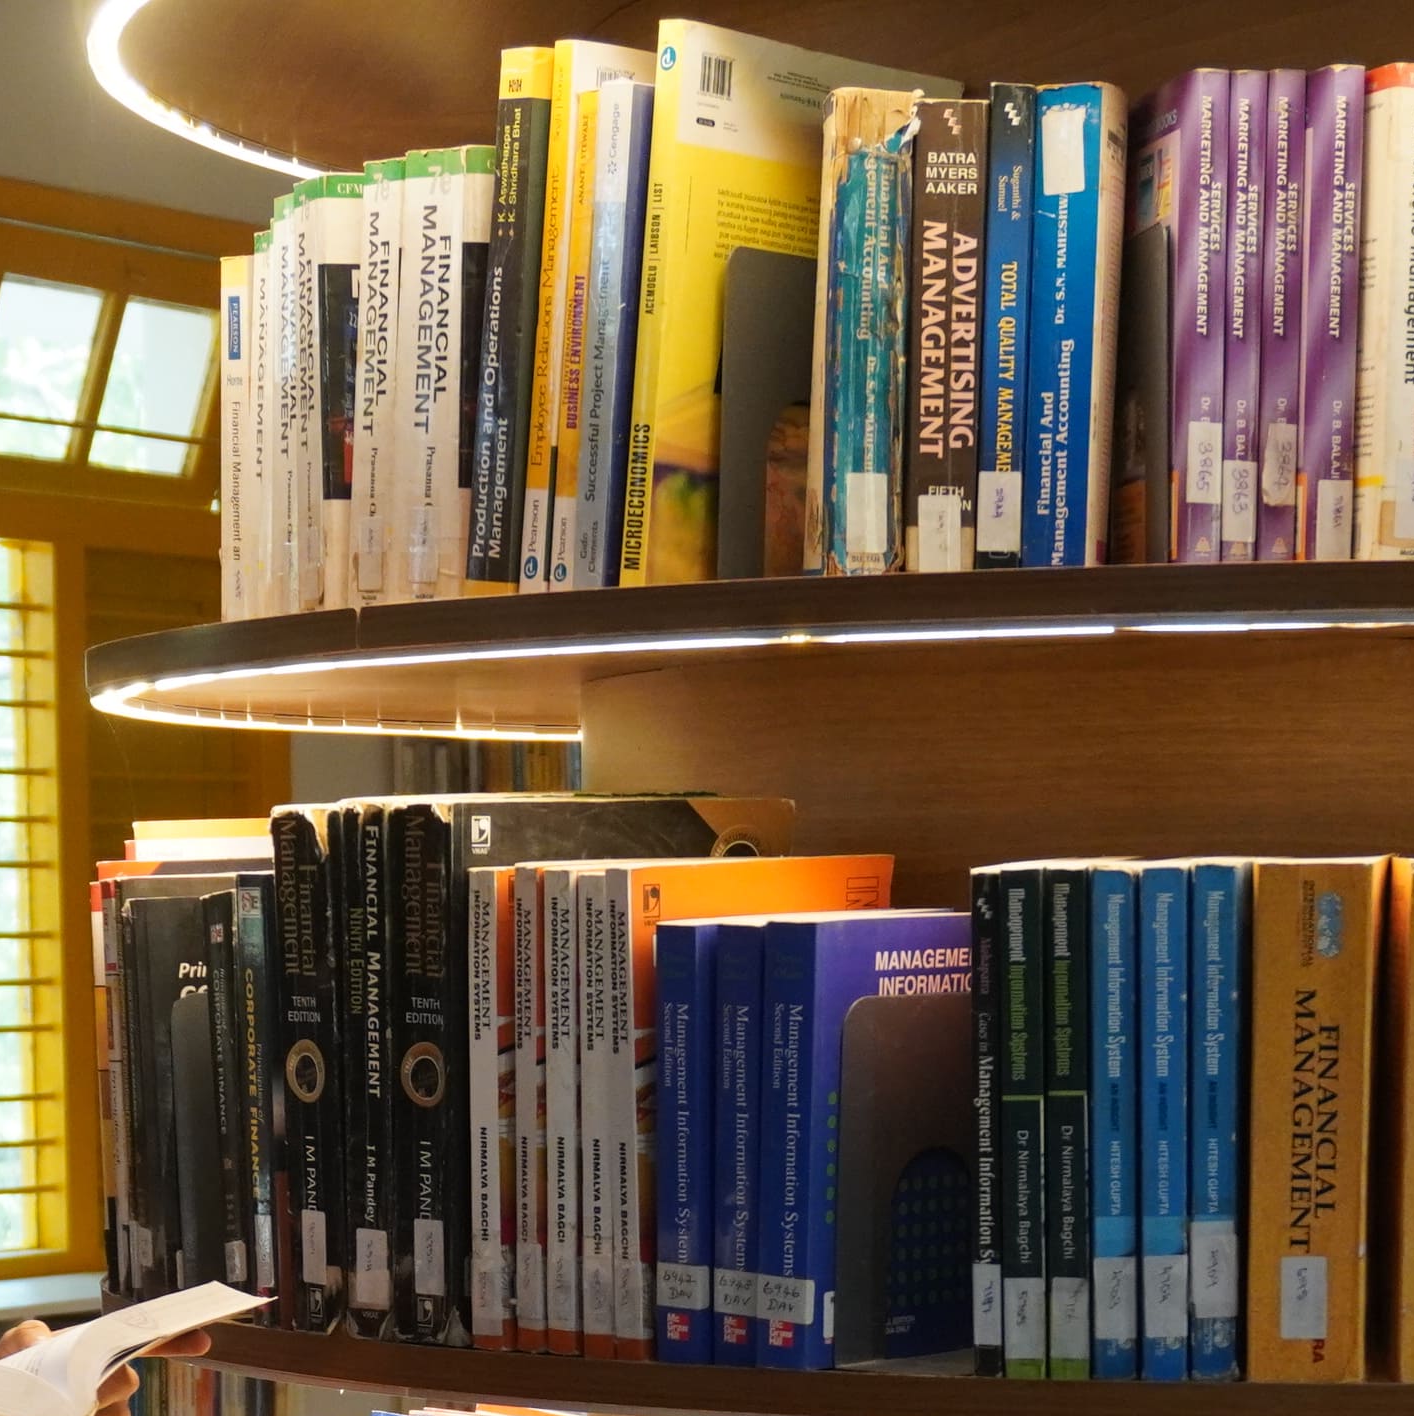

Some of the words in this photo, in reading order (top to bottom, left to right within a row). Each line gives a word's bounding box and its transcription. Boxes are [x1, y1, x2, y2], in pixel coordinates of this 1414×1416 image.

[607, 102, 620, 158] Cengage
[927, 152, 976, 164] BATRA
[1333, 95, 1347, 186] MARKETING
[653, 182, 663, 205] LIST
[925, 166, 978, 179] MYERS
[925, 182, 978, 195] AAKER
[1333, 191, 1344, 221] AND
[543, 173, 559, 285] Management
[650, 210, 662, 255] LAIBSON
[1342, 182, 1355, 253] SERVICES
[434, 235, 451, 403] FINANCIAL
[644, 265, 657, 315] ACEMOGLU
[1328, 226, 1344, 338] MANAGEMENT
[229, 302, 240, 354] PEARSON
[414, 205, 437, 434] MANAGEMENT
[484, 266, 503, 384] Operations
[537, 295, 550, 379] Relations
[919, 219, 946, 459] MANAGEMENT
[949, 231, 979, 448] ADVERTISING
[532, 392, 544, 466] Employee
[1040, 391, 1054, 431] And
[1057, 338, 1075, 459] Accounting
[480, 420, 493, 460] and
[1037, 438, 1053, 516] Financial
[471, 466, 489, 558] Production
[488, 417, 507, 558] Management
[624, 423, 651, 570] MICROECONOMICS
[1051, 465, 1068, 566] Management
[527, 500, 540, 552] Pearson
[406, 1012, 443, 1026] EDITION
[412, 997, 440, 1011] TENTH
[786, 1003, 804, 1107] Management
[1061, 1125, 1071, 1144] Dr
[1289, 989, 1317, 1253] MANAGEMENT
[1314, 1025, 1340, 1218] FINANCIAL
[479, 1127, 488, 1191] NIRMALYA
[786, 1114, 800, 1208] Information
[1061, 1149, 1073, 1224] Nirmalaya
[481, 1194, 489, 1241] BAGCHI
[784, 1215, 800, 1279] Systems
[1062, 1228, 1074, 1259] Bagchi
